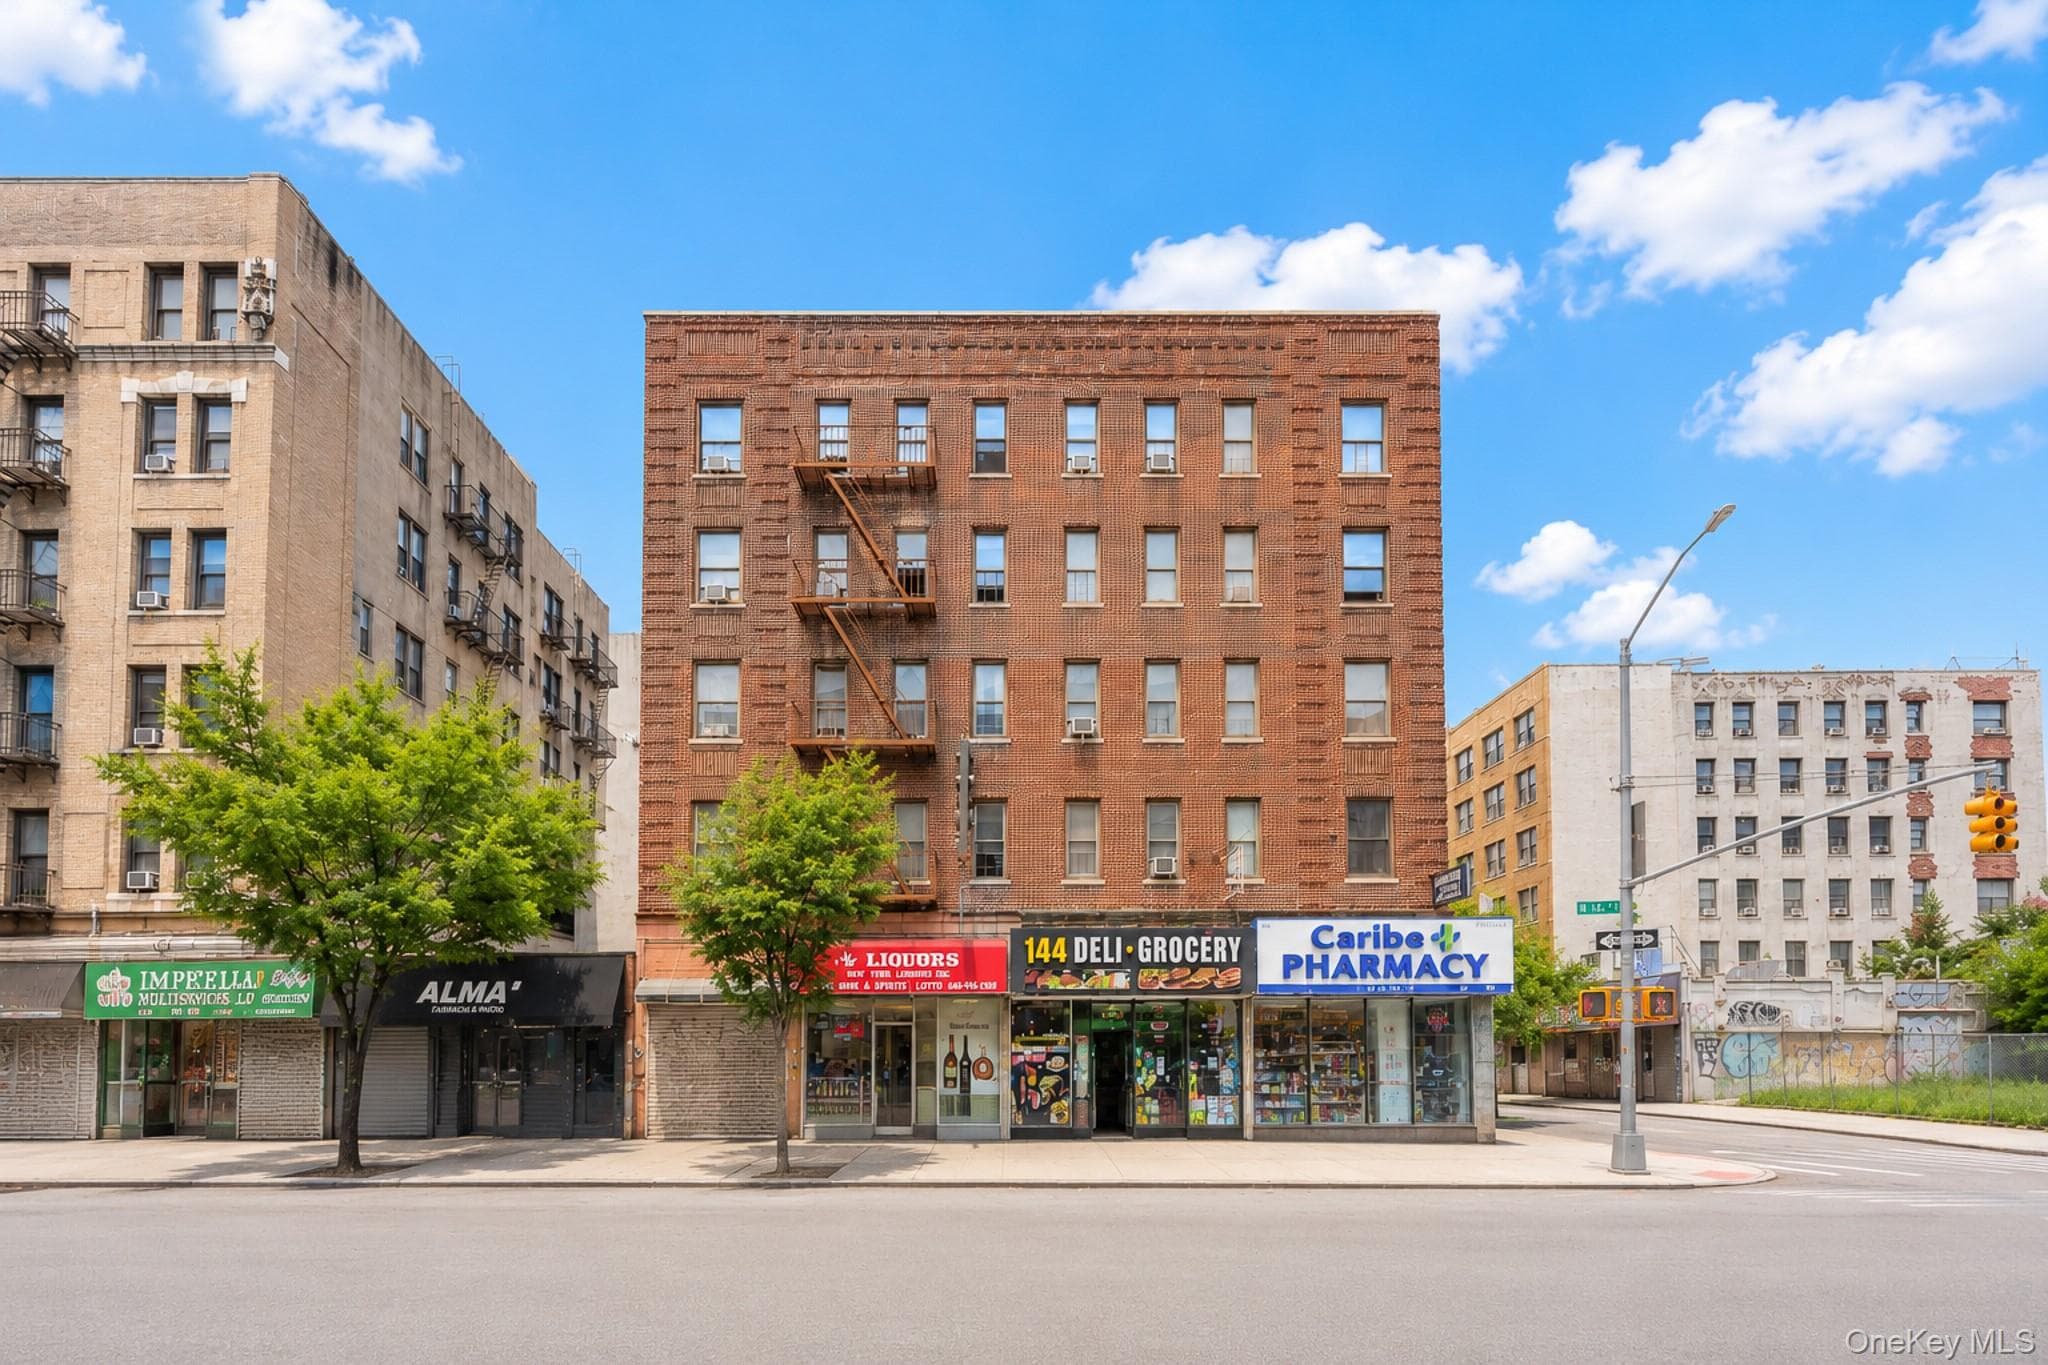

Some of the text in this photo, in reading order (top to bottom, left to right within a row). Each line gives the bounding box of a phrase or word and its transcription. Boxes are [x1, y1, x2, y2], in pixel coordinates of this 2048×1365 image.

[1025, 936, 1241, 964] 144 DELI GROCERY
[1310, 923, 1425, 950] Caribe
[1282, 953, 1490, 980] PHARMACY
[915, 981, 943, 991] LOTTO
